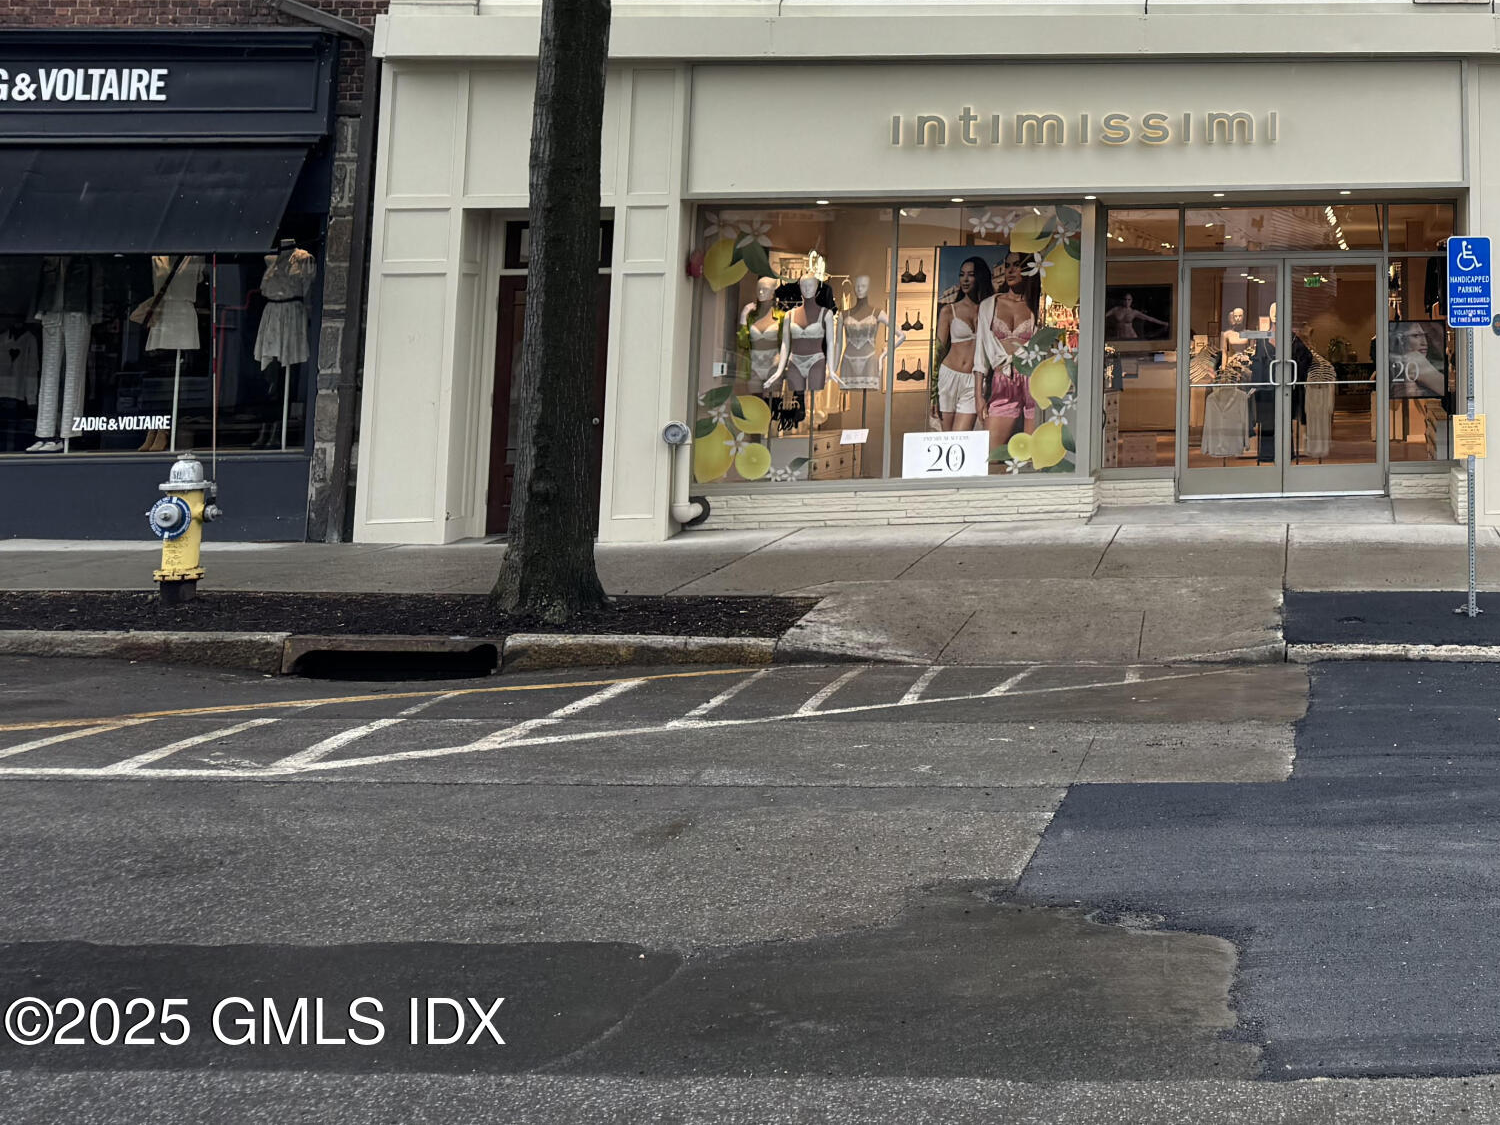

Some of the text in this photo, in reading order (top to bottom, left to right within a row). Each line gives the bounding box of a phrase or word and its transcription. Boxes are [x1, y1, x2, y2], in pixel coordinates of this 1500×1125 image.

[890, 106, 1278, 146] intimissimi
[1449, 275, 1490, 283] HANDICAPPED
[1392, 361, 1419, 382] 20
[72, 415, 171, 431] ZADIG&VOLTAIRE
[926, 443, 965, 472] 20
